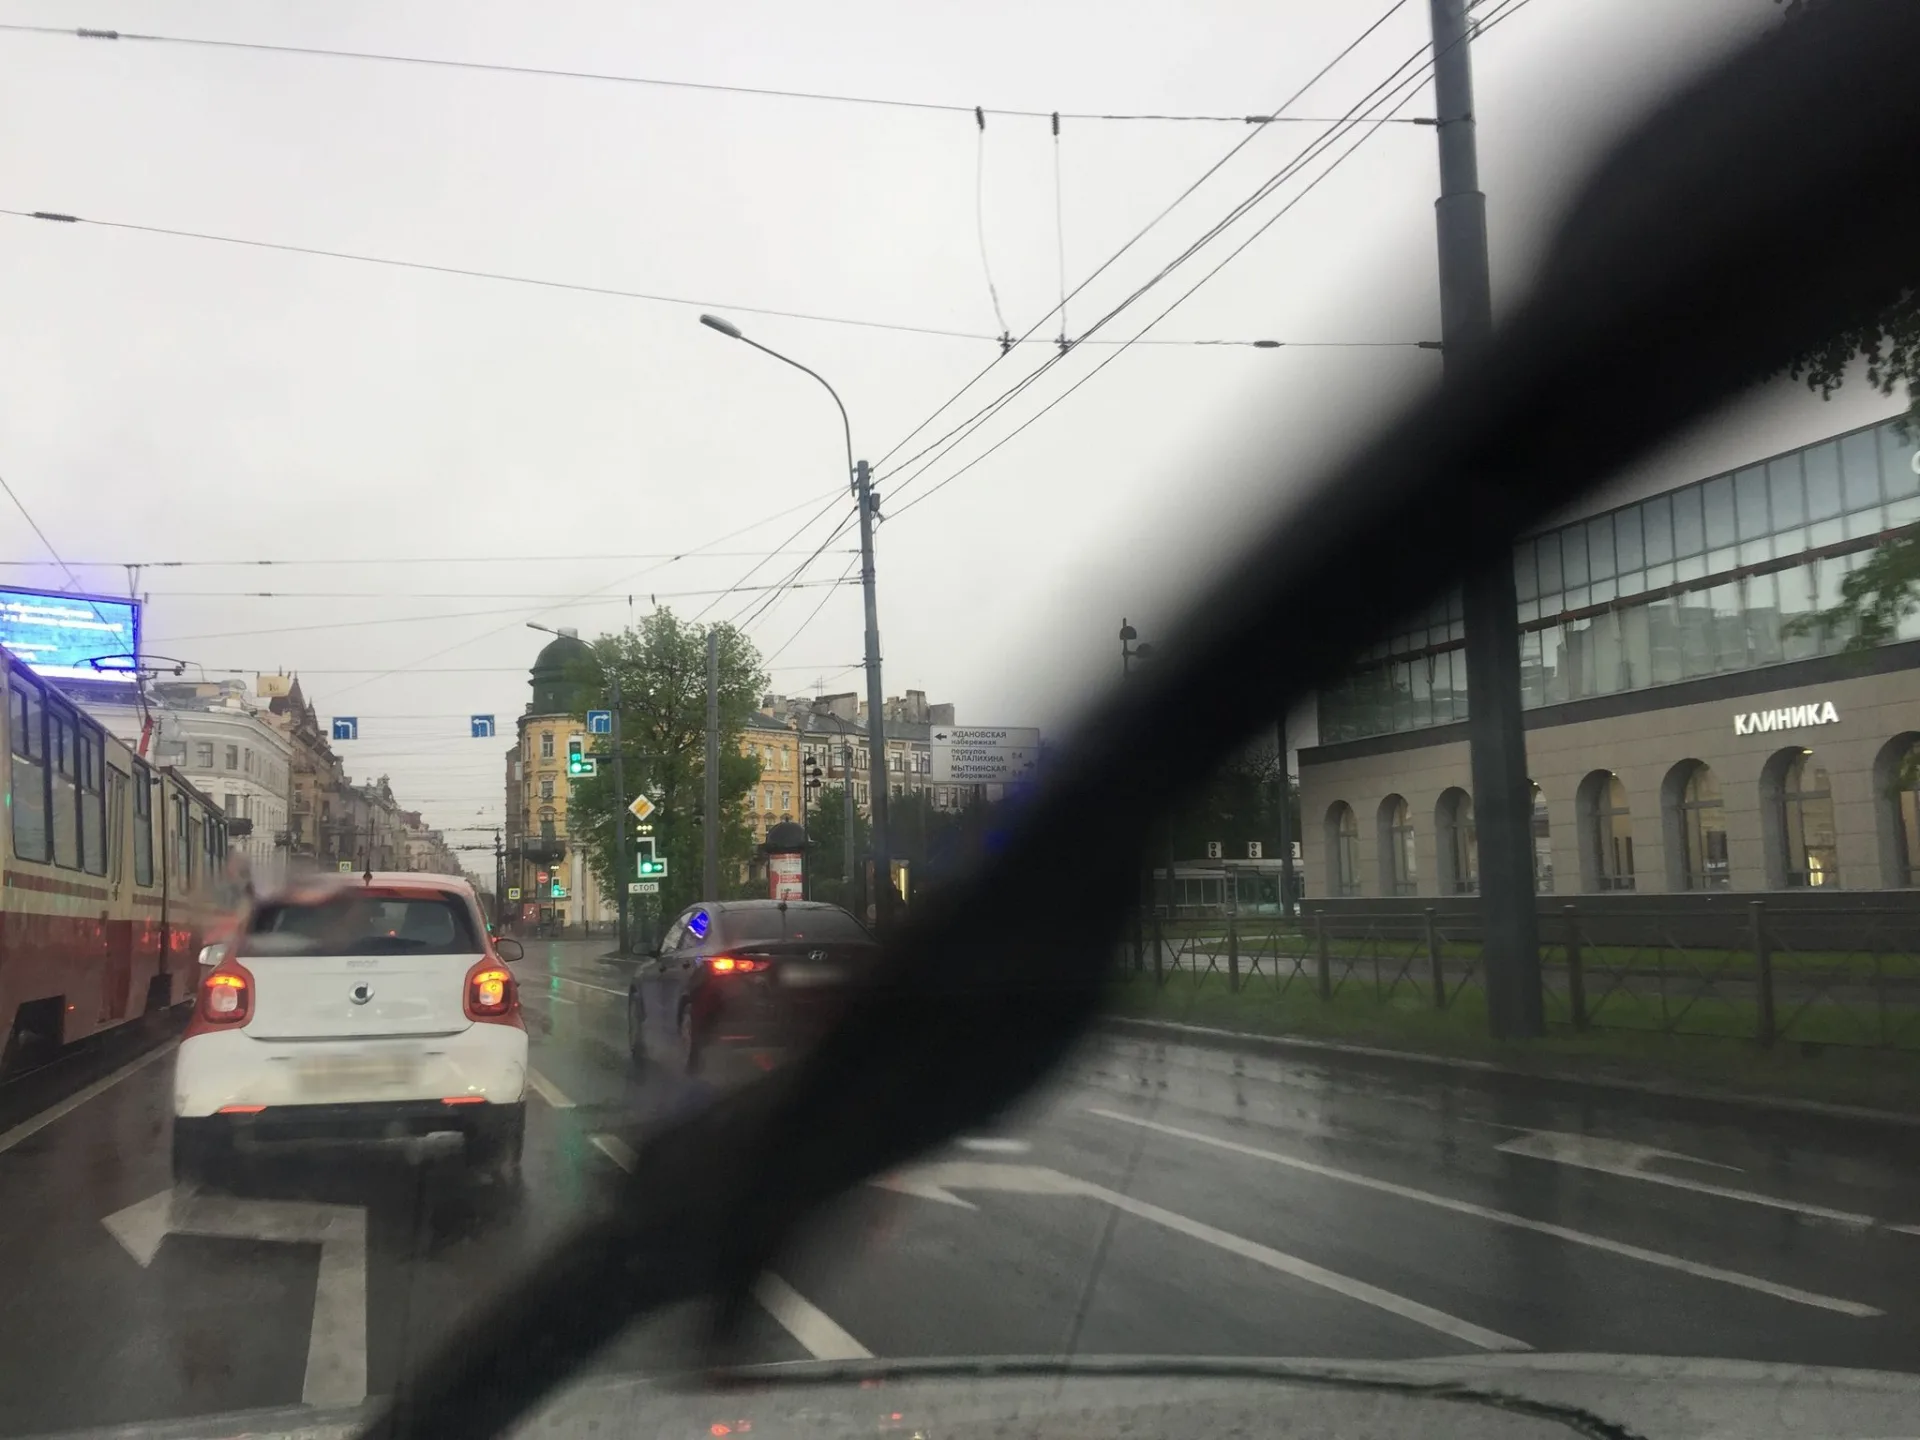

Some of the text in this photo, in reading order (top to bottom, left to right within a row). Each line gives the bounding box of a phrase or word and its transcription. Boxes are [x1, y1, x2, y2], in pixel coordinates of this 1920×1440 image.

[1734, 701, 1840, 735] КЛИНИКА
[951, 730, 1007, 738] ЖДАНОВСКАЯ
[951, 738, 997, 746] набережная
[951, 772, 997, 780] набережная
